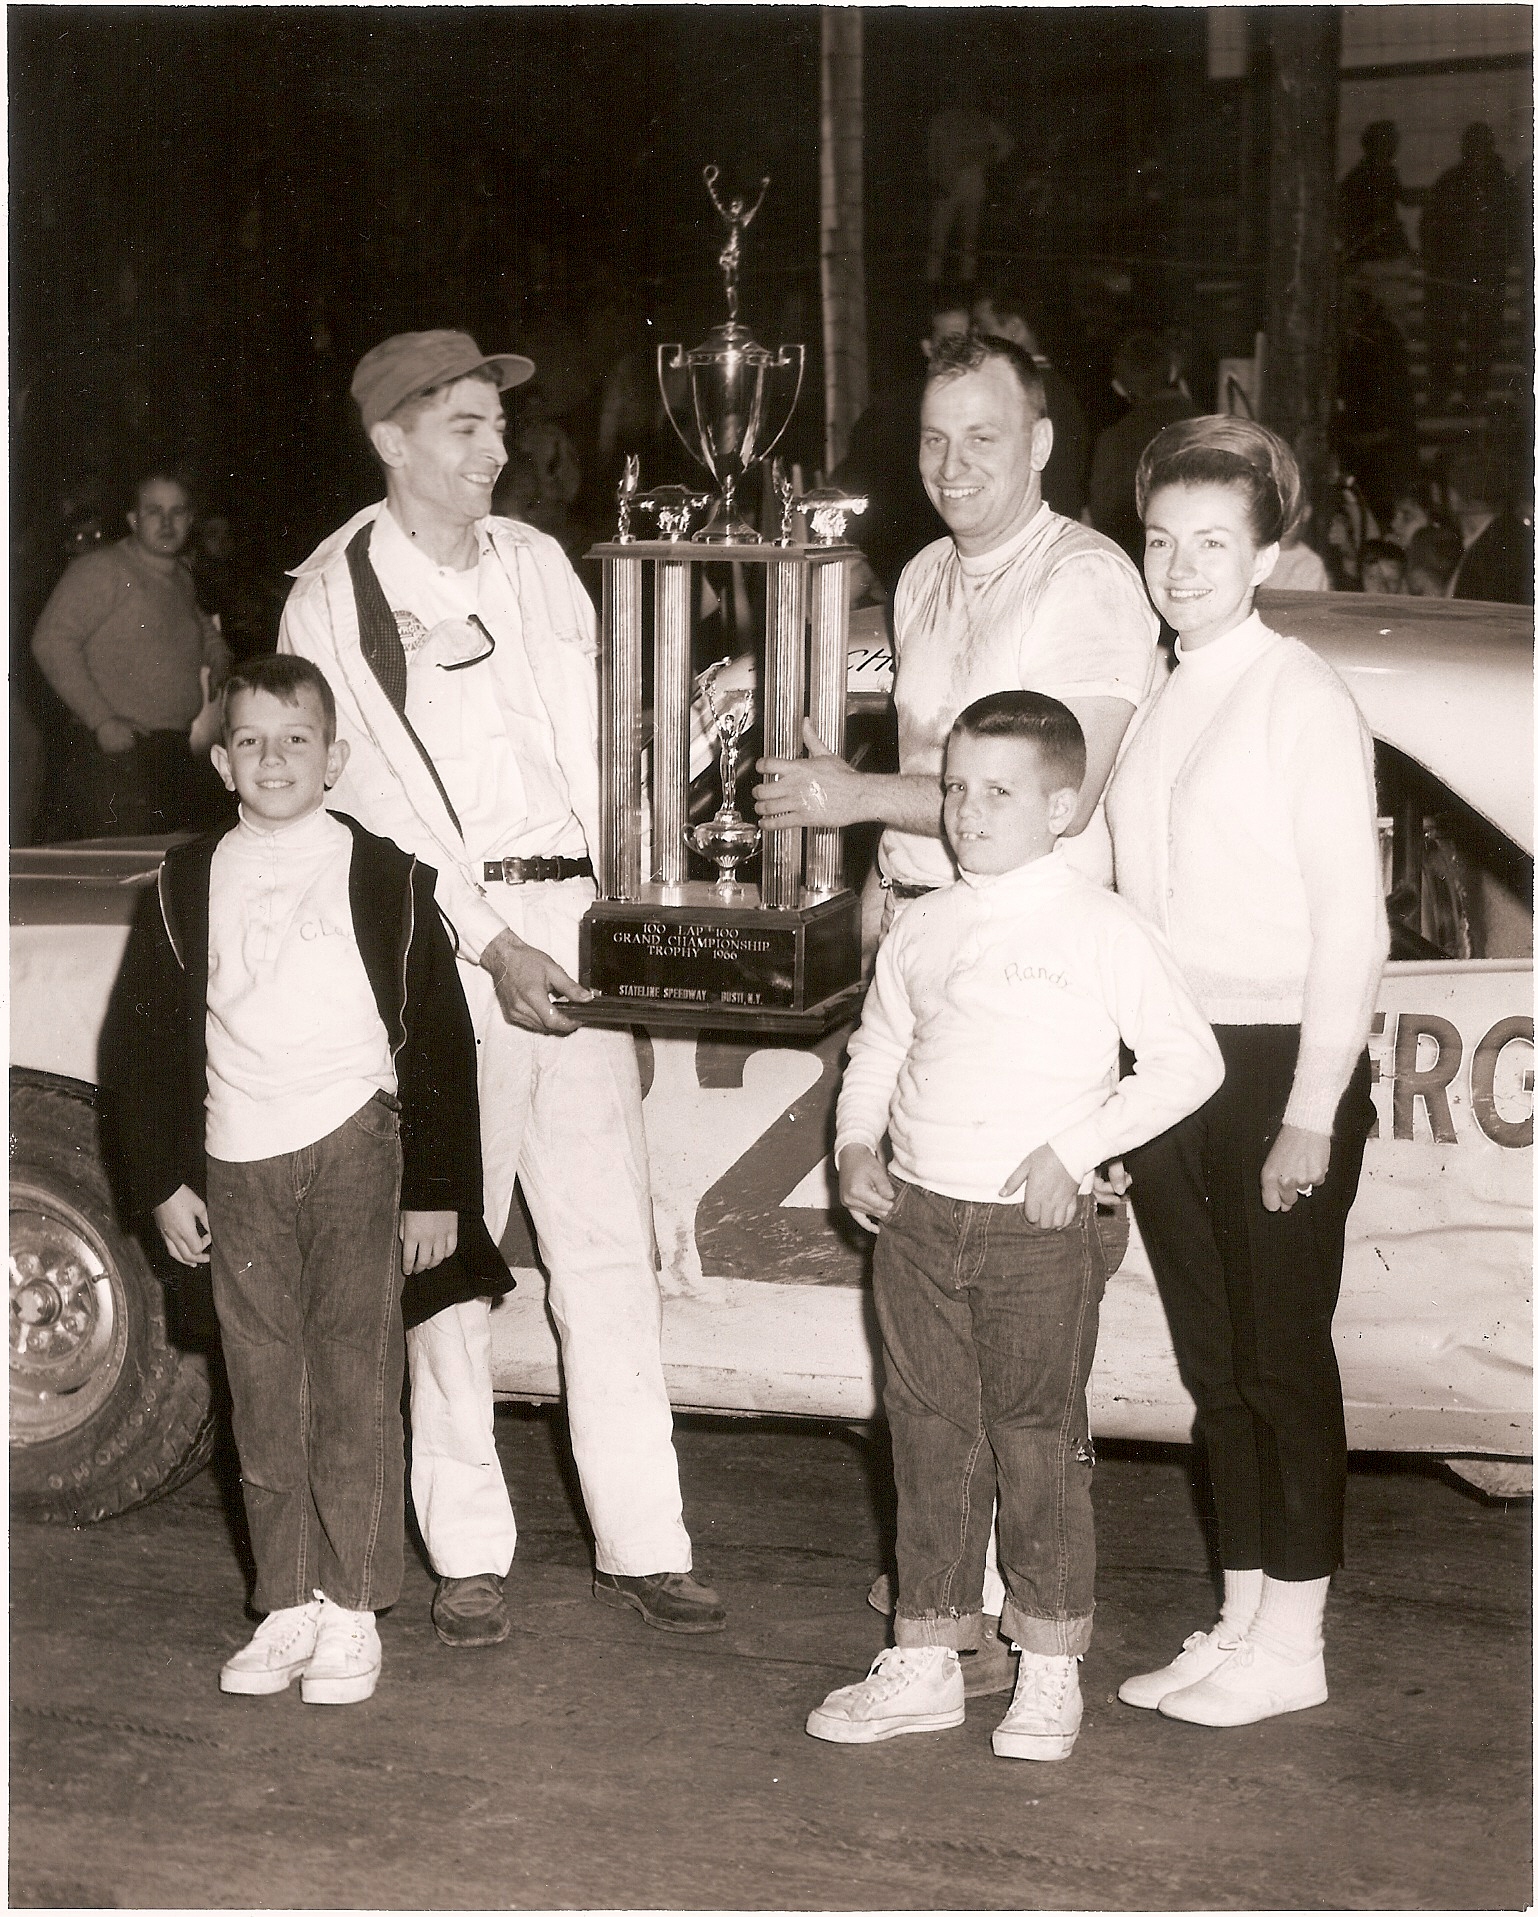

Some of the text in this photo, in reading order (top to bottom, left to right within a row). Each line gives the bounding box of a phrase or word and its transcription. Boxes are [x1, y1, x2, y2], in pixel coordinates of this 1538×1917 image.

[643, 923, 739, 938] 100 LAP 100
[613, 932, 770, 952] GRAND CHAMPIONSHIP
[647, 945, 738, 960] TROPHY 1966
[618, 984, 661, 998] STATELINE
[663, 987, 707, 1001] SPEEDWAY
